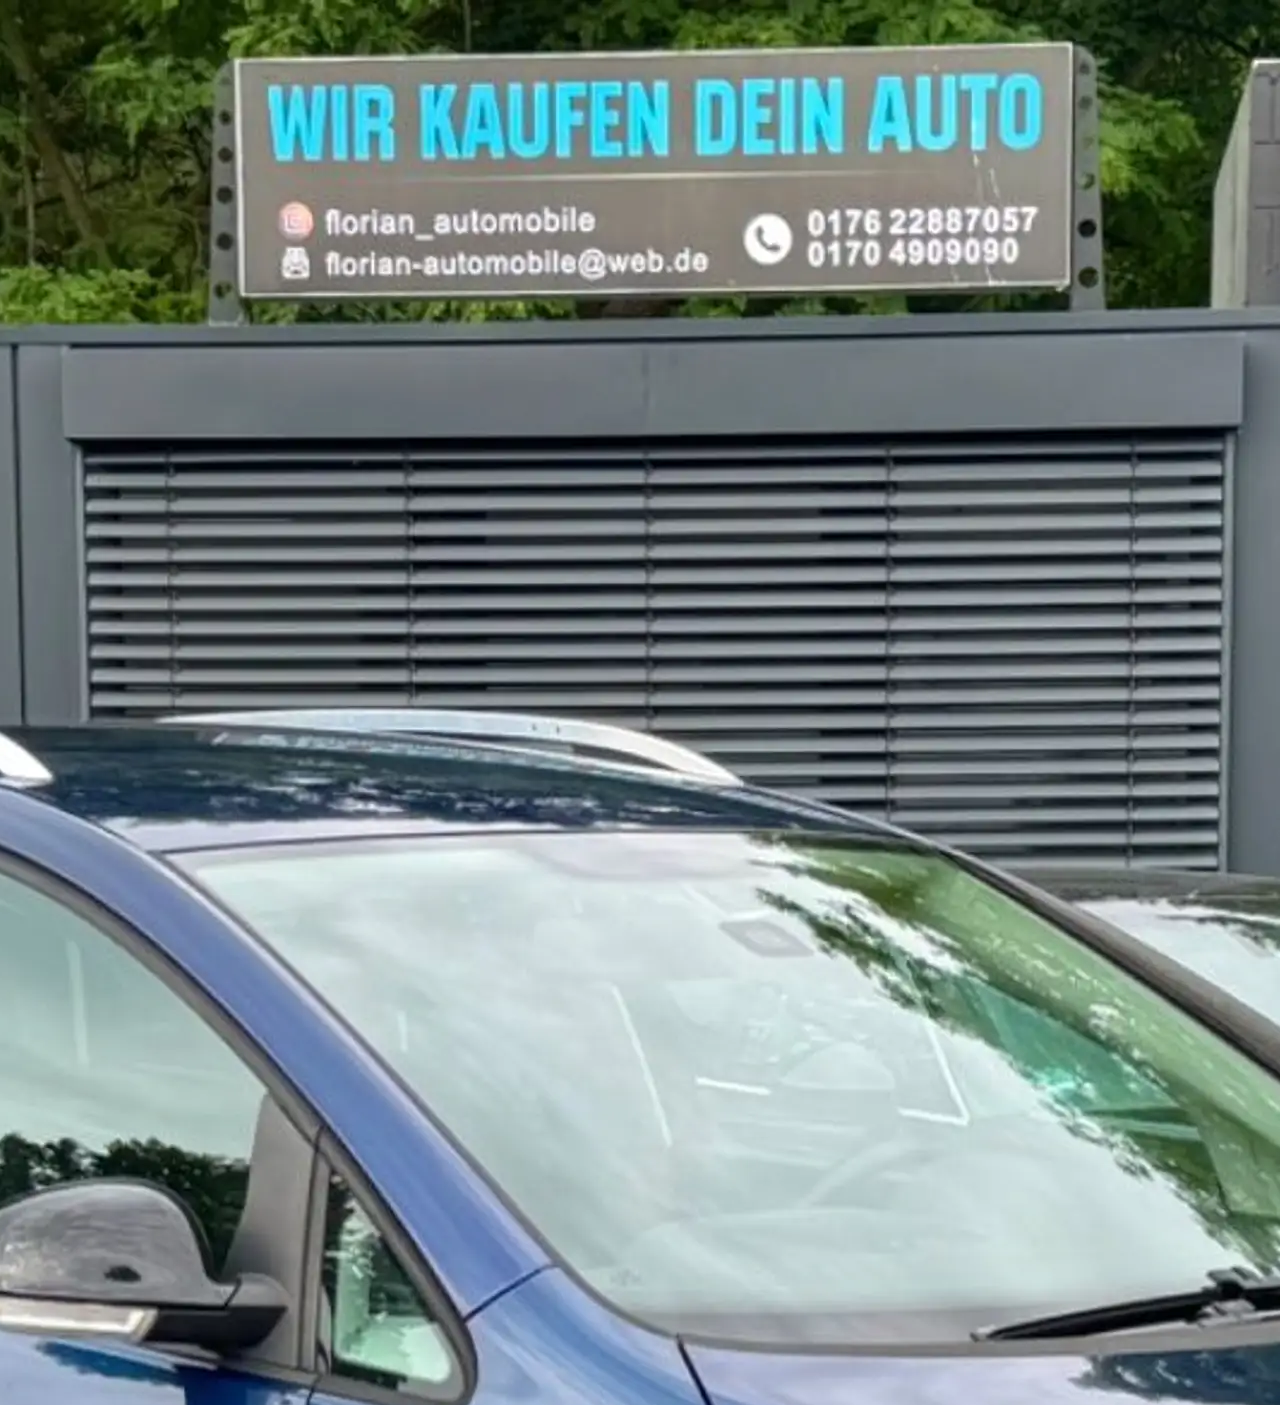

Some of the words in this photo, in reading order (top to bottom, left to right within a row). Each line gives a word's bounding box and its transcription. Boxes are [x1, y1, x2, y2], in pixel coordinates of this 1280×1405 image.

[267, 84, 396, 162] WIR
[420, 80, 670, 160] KAUFEN
[695, 77, 844, 157] DEIN
[867, 72, 1043, 153] AUTO
[324, 207, 596, 241] florian_automobile
[806, 208, 881, 237] 0176
[888, 206, 1039, 236] 22887057
[324, 247, 709, 281] florian-automobile@web.de
[806, 239, 881, 267] 0170
[888, 237, 1019, 266] 4909090
